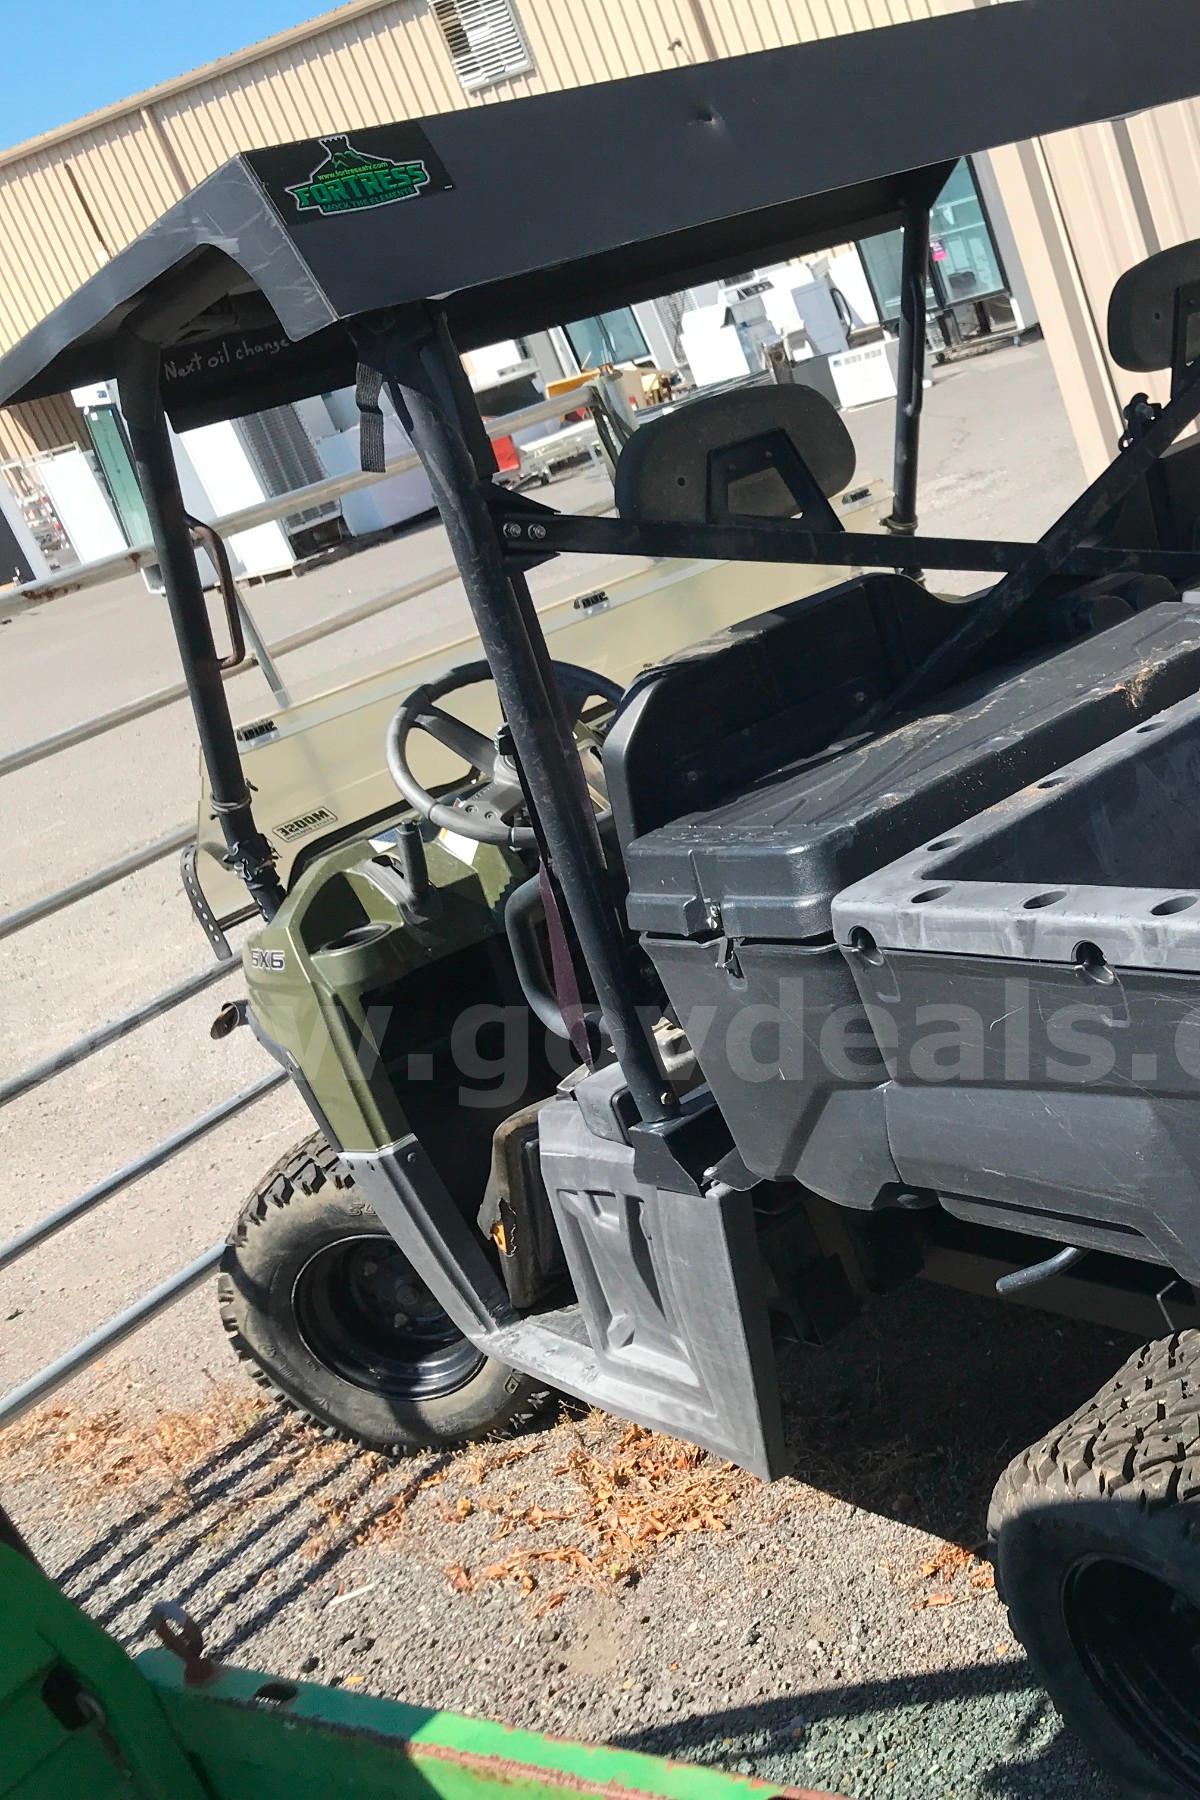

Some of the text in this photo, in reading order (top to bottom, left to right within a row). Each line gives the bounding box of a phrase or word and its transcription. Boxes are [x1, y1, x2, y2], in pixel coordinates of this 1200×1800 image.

[294, 164, 427, 207] FORTRESS
[351, 198, 368, 208] THE
[370, 186, 415, 203] ELEMENTS
[164, 339, 290, 380] Next oil change
